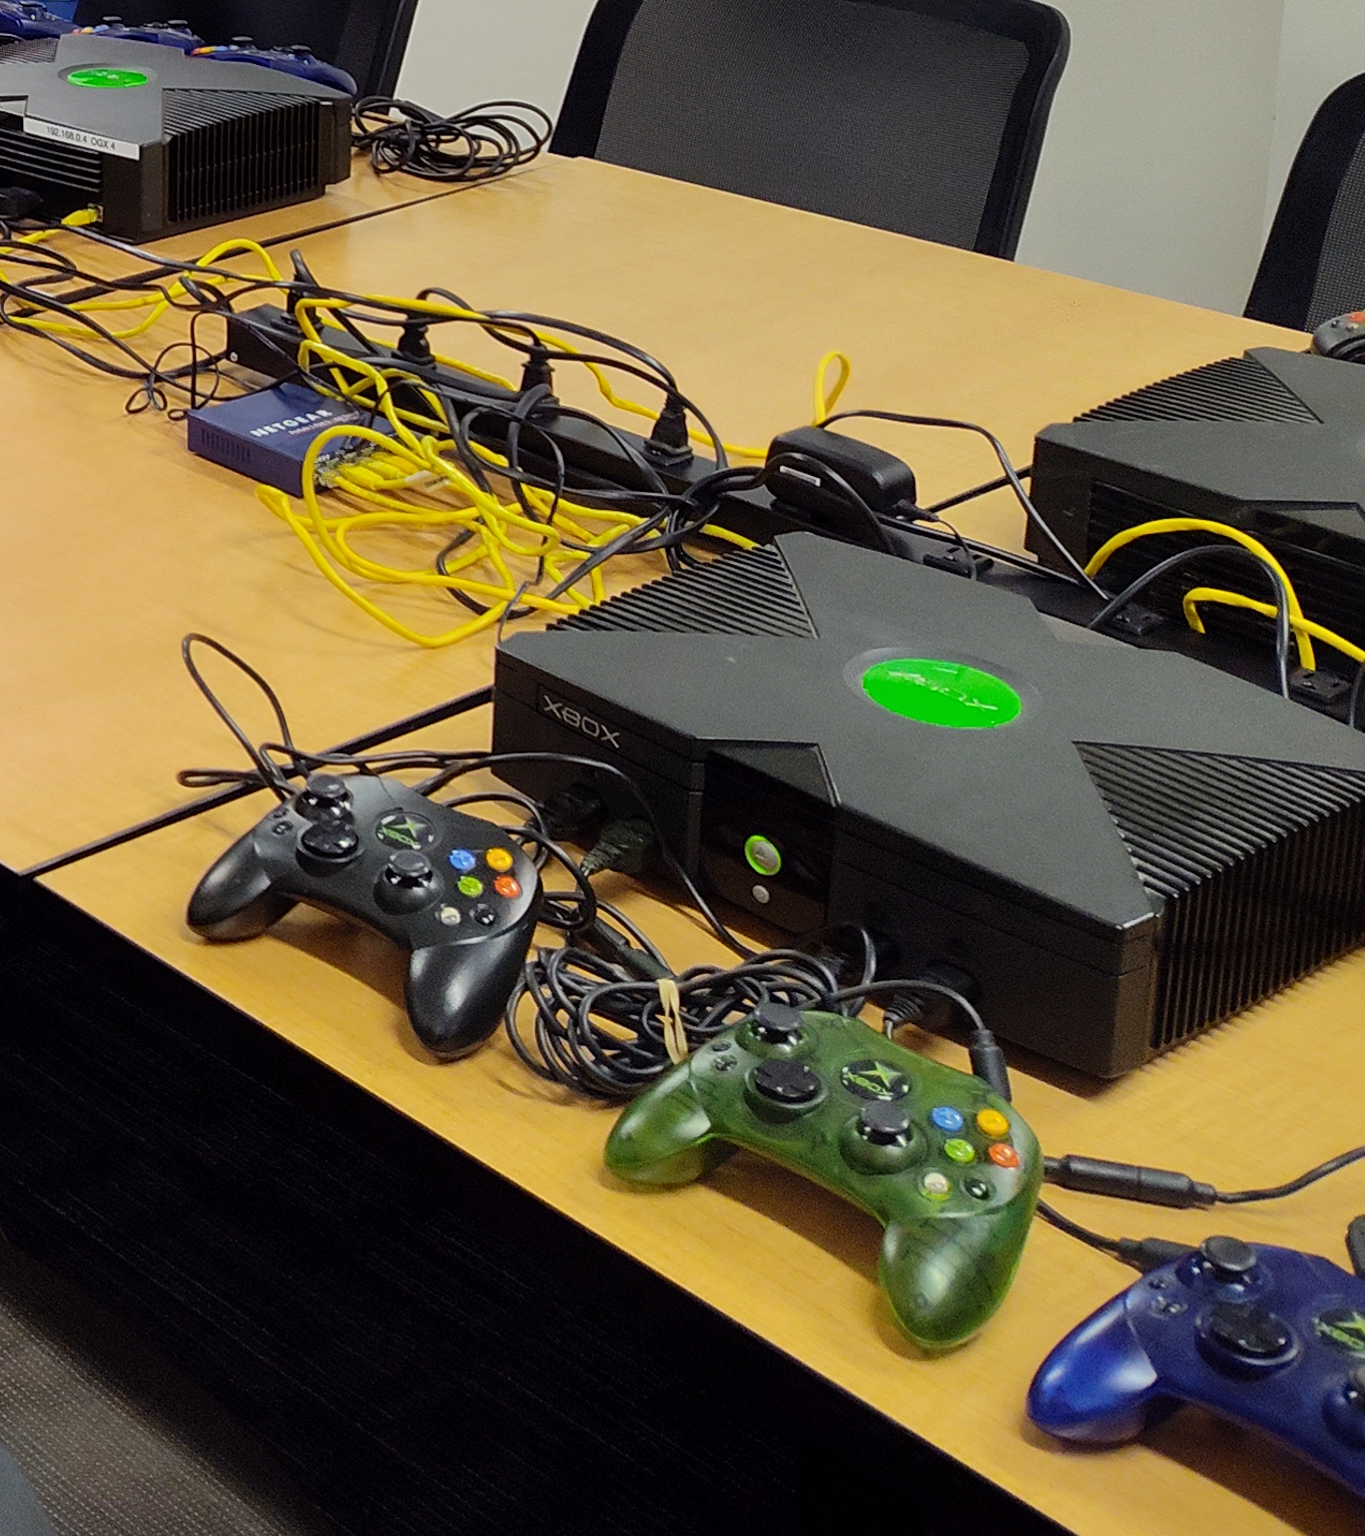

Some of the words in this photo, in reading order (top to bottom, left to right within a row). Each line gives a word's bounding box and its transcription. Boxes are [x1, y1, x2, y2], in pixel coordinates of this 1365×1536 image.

[46, 126, 88, 144] 192.168.0.4
[90, 137, 109, 148] OGX
[110, 142, 116, 150] 4
[249, 409, 333, 438] NETGEAR
[543, 694, 621, 749] XBOX
